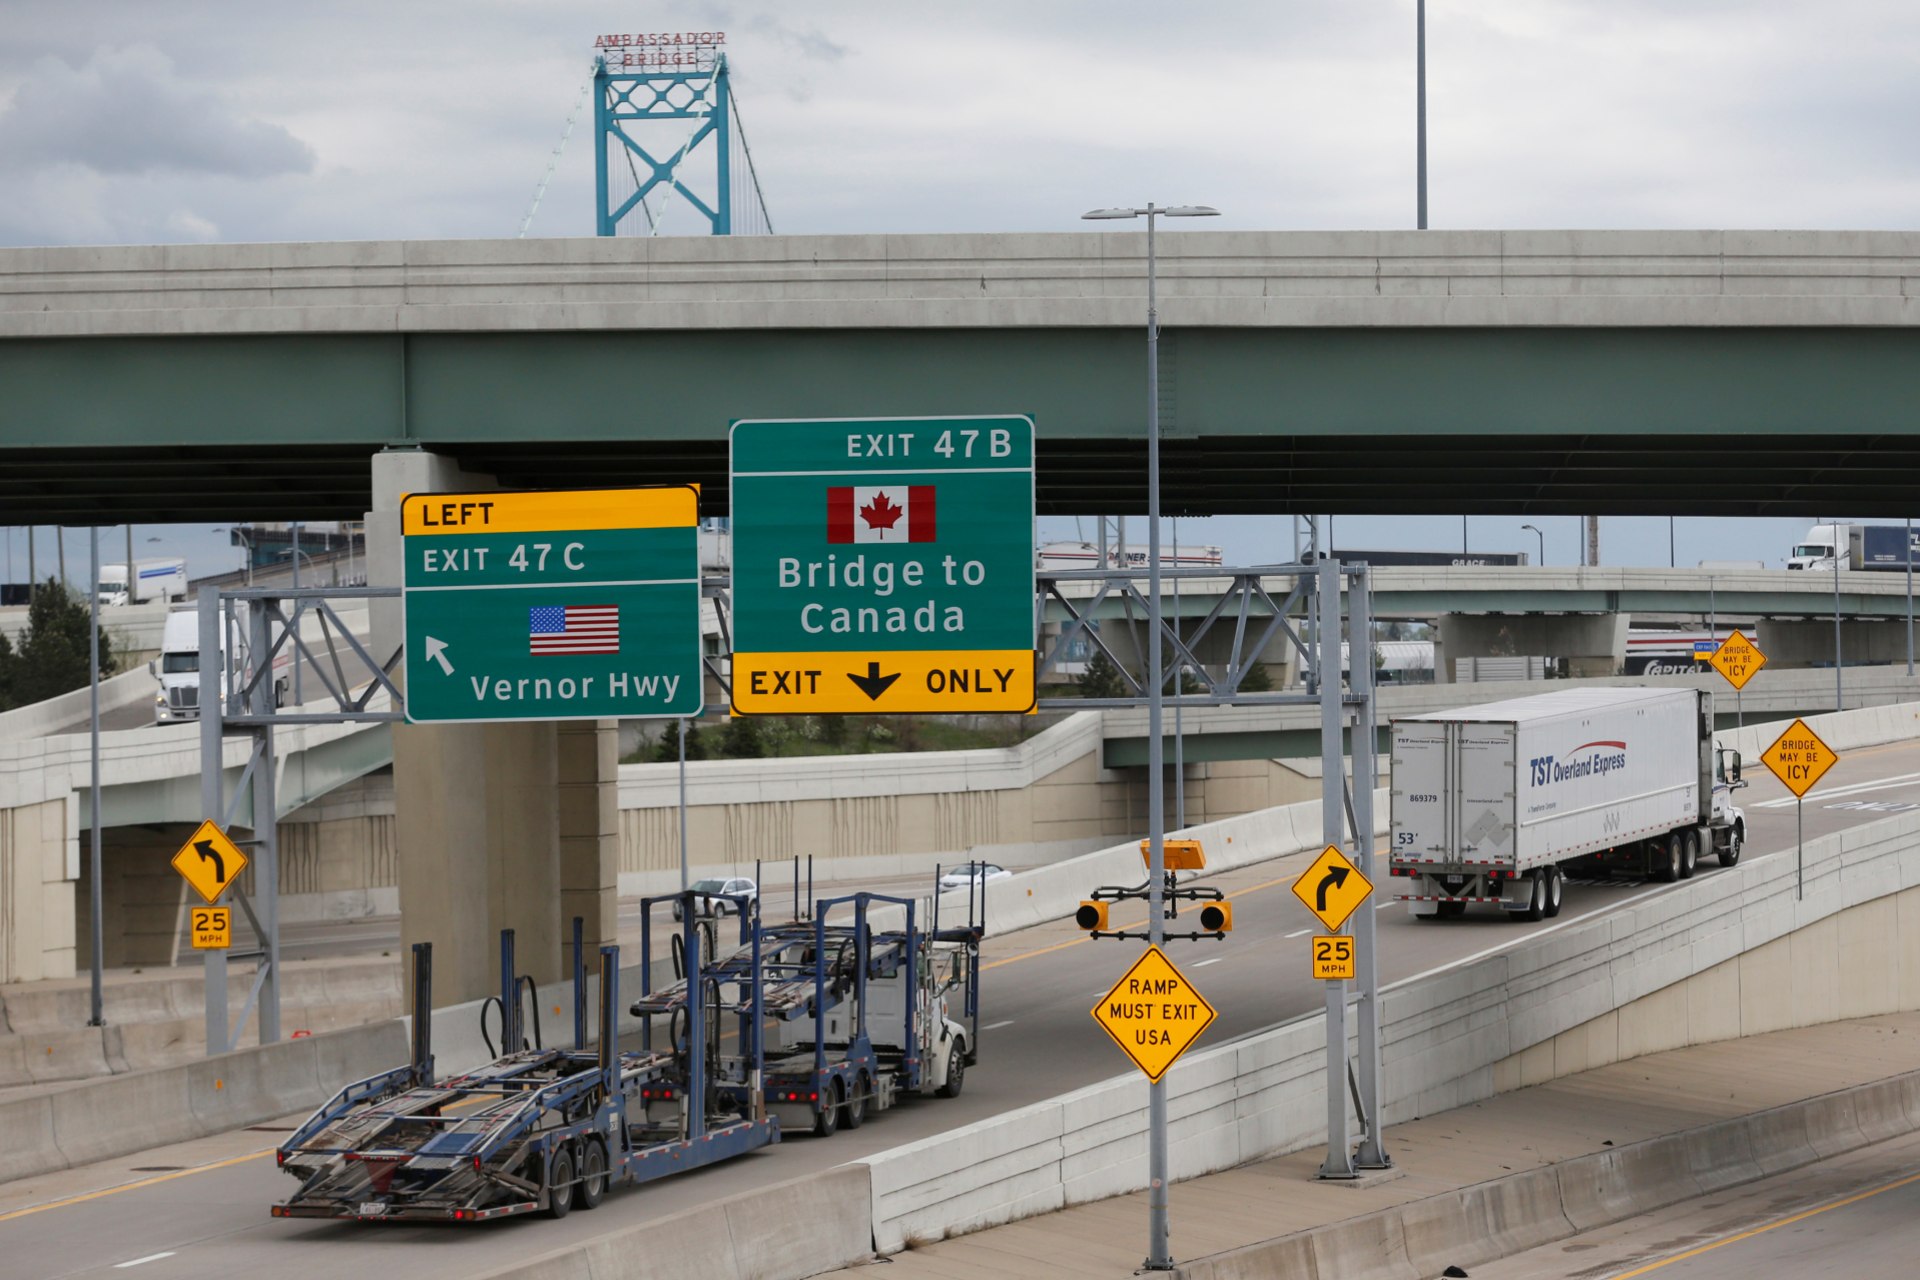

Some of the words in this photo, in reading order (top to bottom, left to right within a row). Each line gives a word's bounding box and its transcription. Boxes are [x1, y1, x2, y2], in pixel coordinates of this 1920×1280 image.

[595, 32, 725, 47] AMBASSADOR
[623, 52, 697, 66] BRIDGE
[847, 433, 915, 458] EXIT
[933, 430, 980, 459] 47
[990, 429, 1012, 458] B
[423, 502, 494, 527] LEFT
[423, 548, 490, 573] EXIT
[508, 543, 552, 572] 47
[563, 542, 586, 571] C
[778, 553, 925, 597] Bridge
[941, 554, 987, 586] to
[800, 599, 966, 634] Canada
[1724, 646, 1750, 655] BRIDGE
[1723, 656, 1738, 664] MAY
[1742, 655, 1752, 664] BE
[1729, 665, 1747, 677] ICY
[470, 676, 595, 702] Vernor
[608, 672, 681, 703] Hwy
[750, 670, 823, 695] EXIT
[926, 668, 1016, 694] ONLY
[1782, 740, 1816, 750] BRIDGE
[1779, 752, 1799, 762] MAY
[1806, 752, 1818, 762] BE
[1530, 755, 1554, 788] TST
[1553, 755, 1592, 783] Overland
[1593, 753, 1626, 777] Express
[1787, 764, 1810, 780] ICY
[1409, 794, 1437, 803] 869379
[195, 912, 226, 931] 25
[199, 934, 222, 943] MPH
[1316, 941, 1350, 961] 25
[1321, 964, 1346, 974] MPH
[1130, 979, 1179, 995] RAMP
[1110, 1003, 1154, 1019] MUST
[1162, 1004, 1198, 1020] EXIT
[1135, 1029, 1172, 1045] USA
